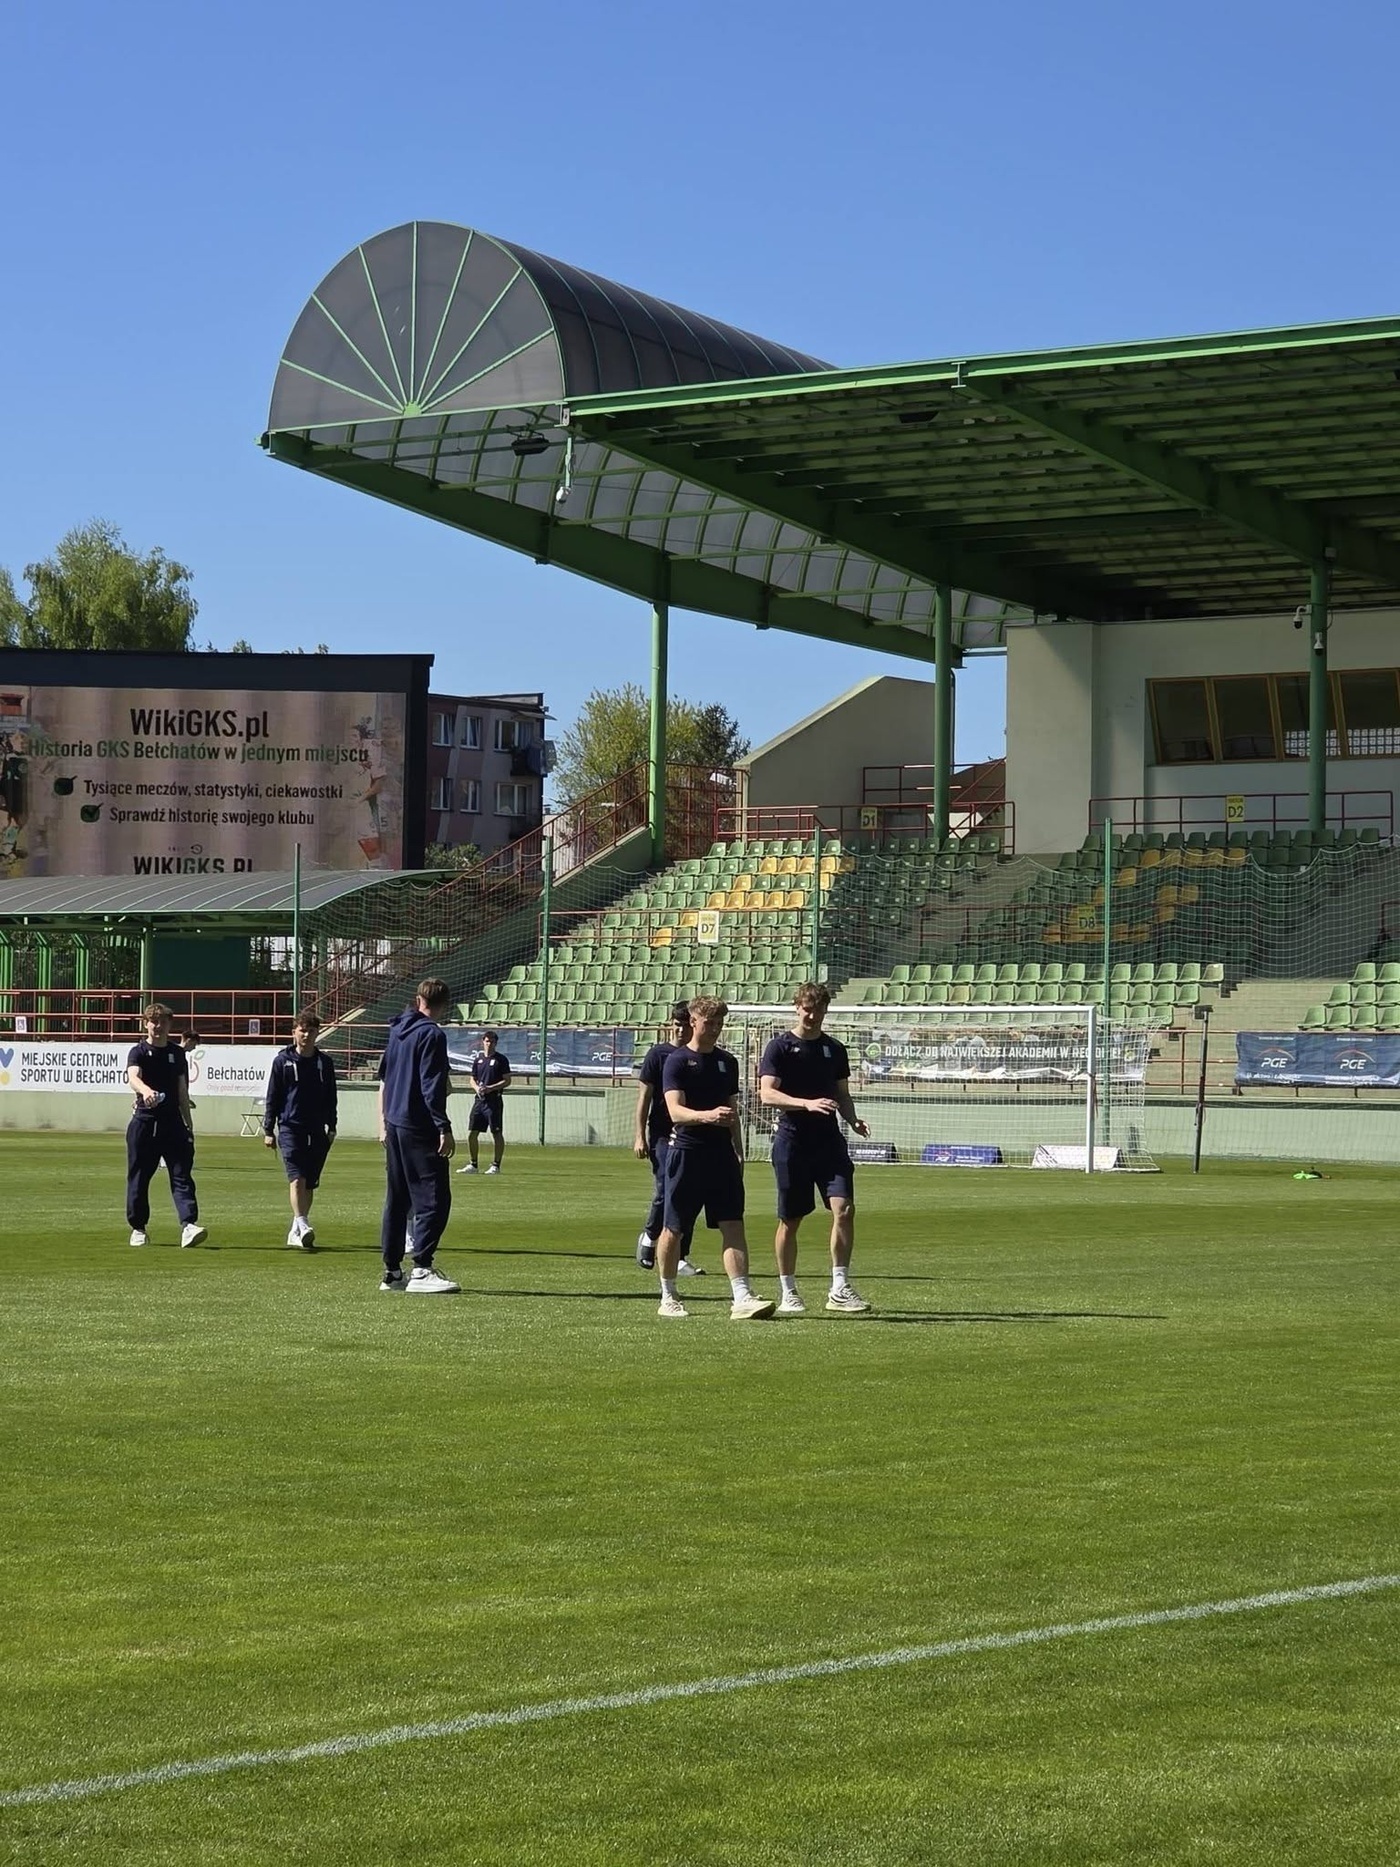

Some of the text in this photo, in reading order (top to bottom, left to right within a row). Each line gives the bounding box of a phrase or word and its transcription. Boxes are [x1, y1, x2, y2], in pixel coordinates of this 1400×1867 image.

[130, 708, 269, 743] WikiGKS.pl
[30, 740, 369, 765] Historia GKS Bełchatów w jednym miejscu
[84, 780, 343, 799] Tysiące meczów, statystyki, ciekawostki
[109, 807, 314, 826] Sprawdź historię swojego klubu
[1228, 805, 1244, 818] D2
[863, 815, 876, 827] D1
[701, 923, 715, 934] D7
[1079, 916, 1095, 929] D8
[591, 1052, 612, 1062] PGE
[1008, 1047, 1057, 1058] AKADEMII
[1060, 1047, 1069, 1058] W
[22, 1052, 118, 1067] MIEJSKIE CENTRUM
[1261, 1057, 1288, 1068] PGE
[1340, 1059, 1367, 1070] PGE
[21, 1069, 129, 1084] SPORTU W BEŁCHATO
[207, 1067, 266, 1080] Bełchatów
